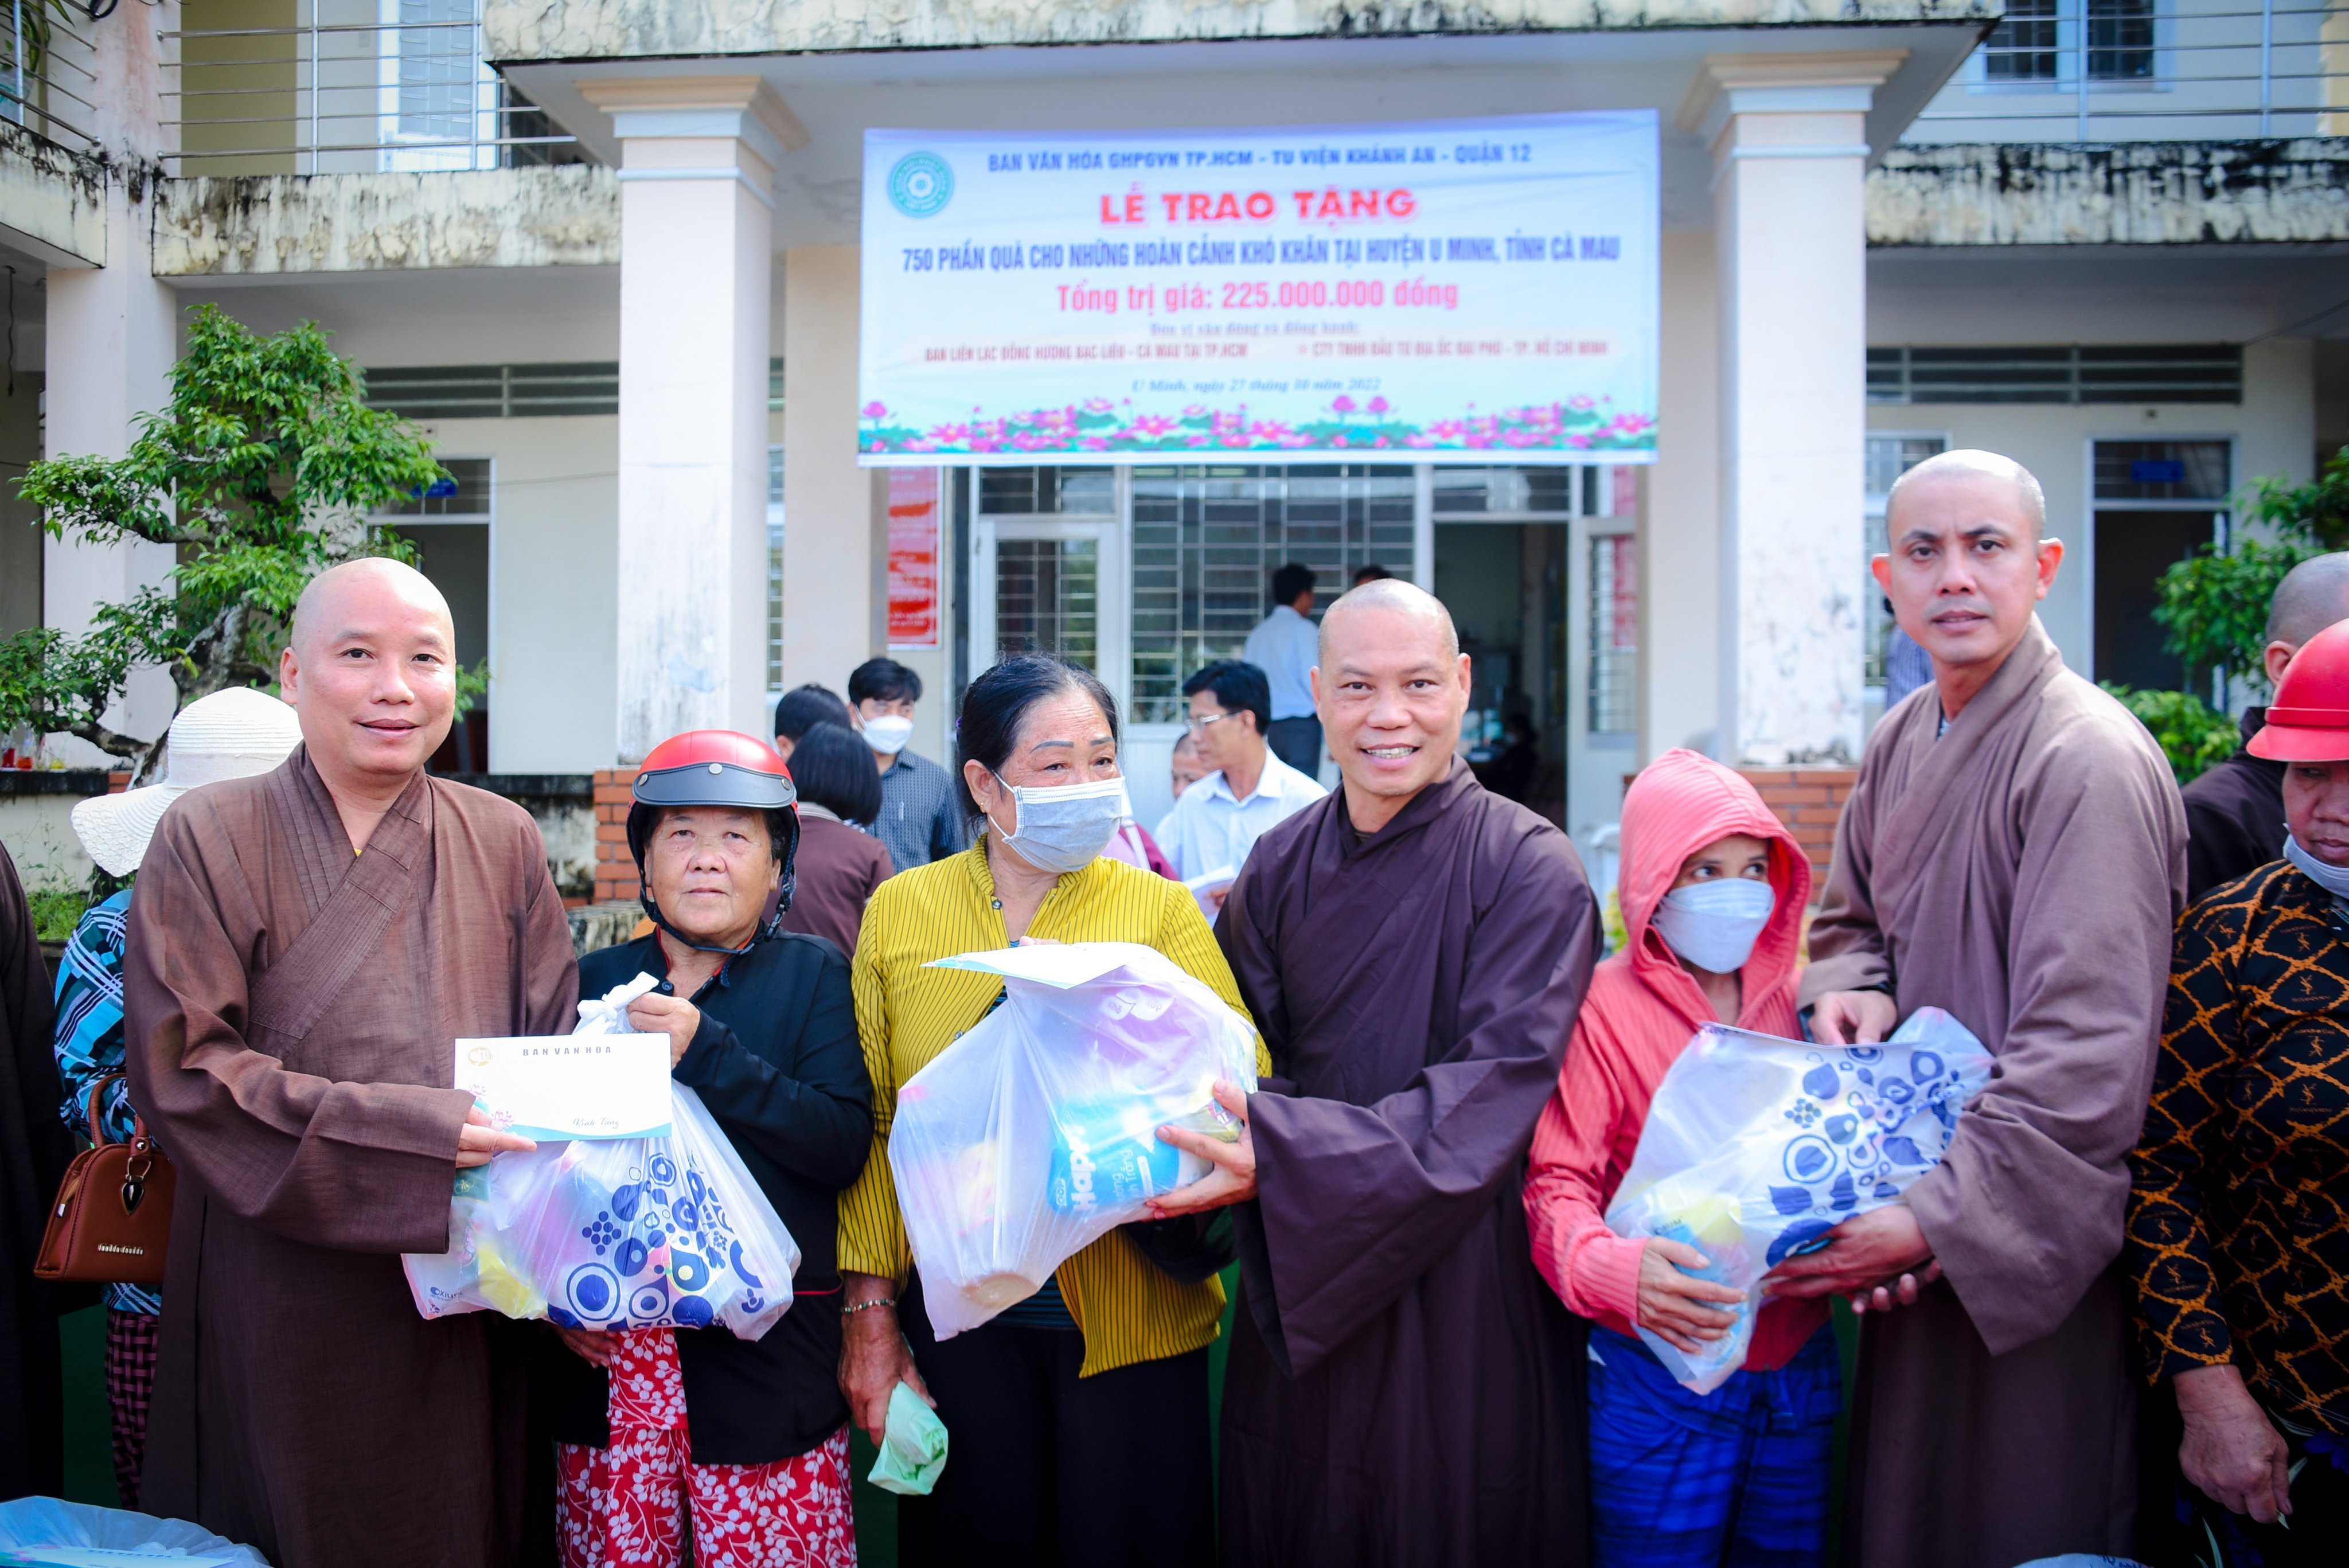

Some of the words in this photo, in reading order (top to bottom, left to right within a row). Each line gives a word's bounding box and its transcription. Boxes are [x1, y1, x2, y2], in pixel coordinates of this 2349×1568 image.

[988, 153, 1022, 171] BAN
[1109, 151, 1179, 169] GHPGVN
[1185, 150, 1253, 166] TP.HCM
[1300, 144, 1340, 168] VIỆN
[1412, 146, 1435, 163] AN
[1454, 141, 1503, 166] QUẬN
[1511, 143, 1532, 163] 12
[1100, 181, 1145, 223] LỄ
[1162, 192, 1275, 222] TRAO
[1293, 185, 1417, 227] TẶNG
[902, 248, 933, 271] 750
[938, 237, 984, 270] PHẦN
[990, 240, 1024, 272] QUÀ
[1031, 244, 1063, 269] CHO
[1070, 238, 1129, 267] NHỮNG
[1134, 236, 1181, 266] HOÀN
[1188, 232, 1235, 265] CẢNH
[1240, 233, 1275, 264] KHÓ
[1281, 234, 1329, 264] KHĂN
[1335, 239, 1361, 268] TẠI
[1366, 232, 1425, 268] HUYỆN
[1430, 237, 1442, 260] U
[1447, 236, 1501, 264] MINH,
[1551, 231, 1575, 261] CÀ
[1580, 236, 1621, 261] MAU
[1058, 278, 1118, 313] Tổng
[1127, 283, 1154, 315] trị
[1165, 281, 1213, 312] giá:
[1222, 280, 1384, 308] 225.000.000
[925, 346, 947, 362] BAN
[1230, 377, 1247, 392] 27
[1348, 376, 1382, 392] 2022
[522, 1048, 548, 1056] BAN
